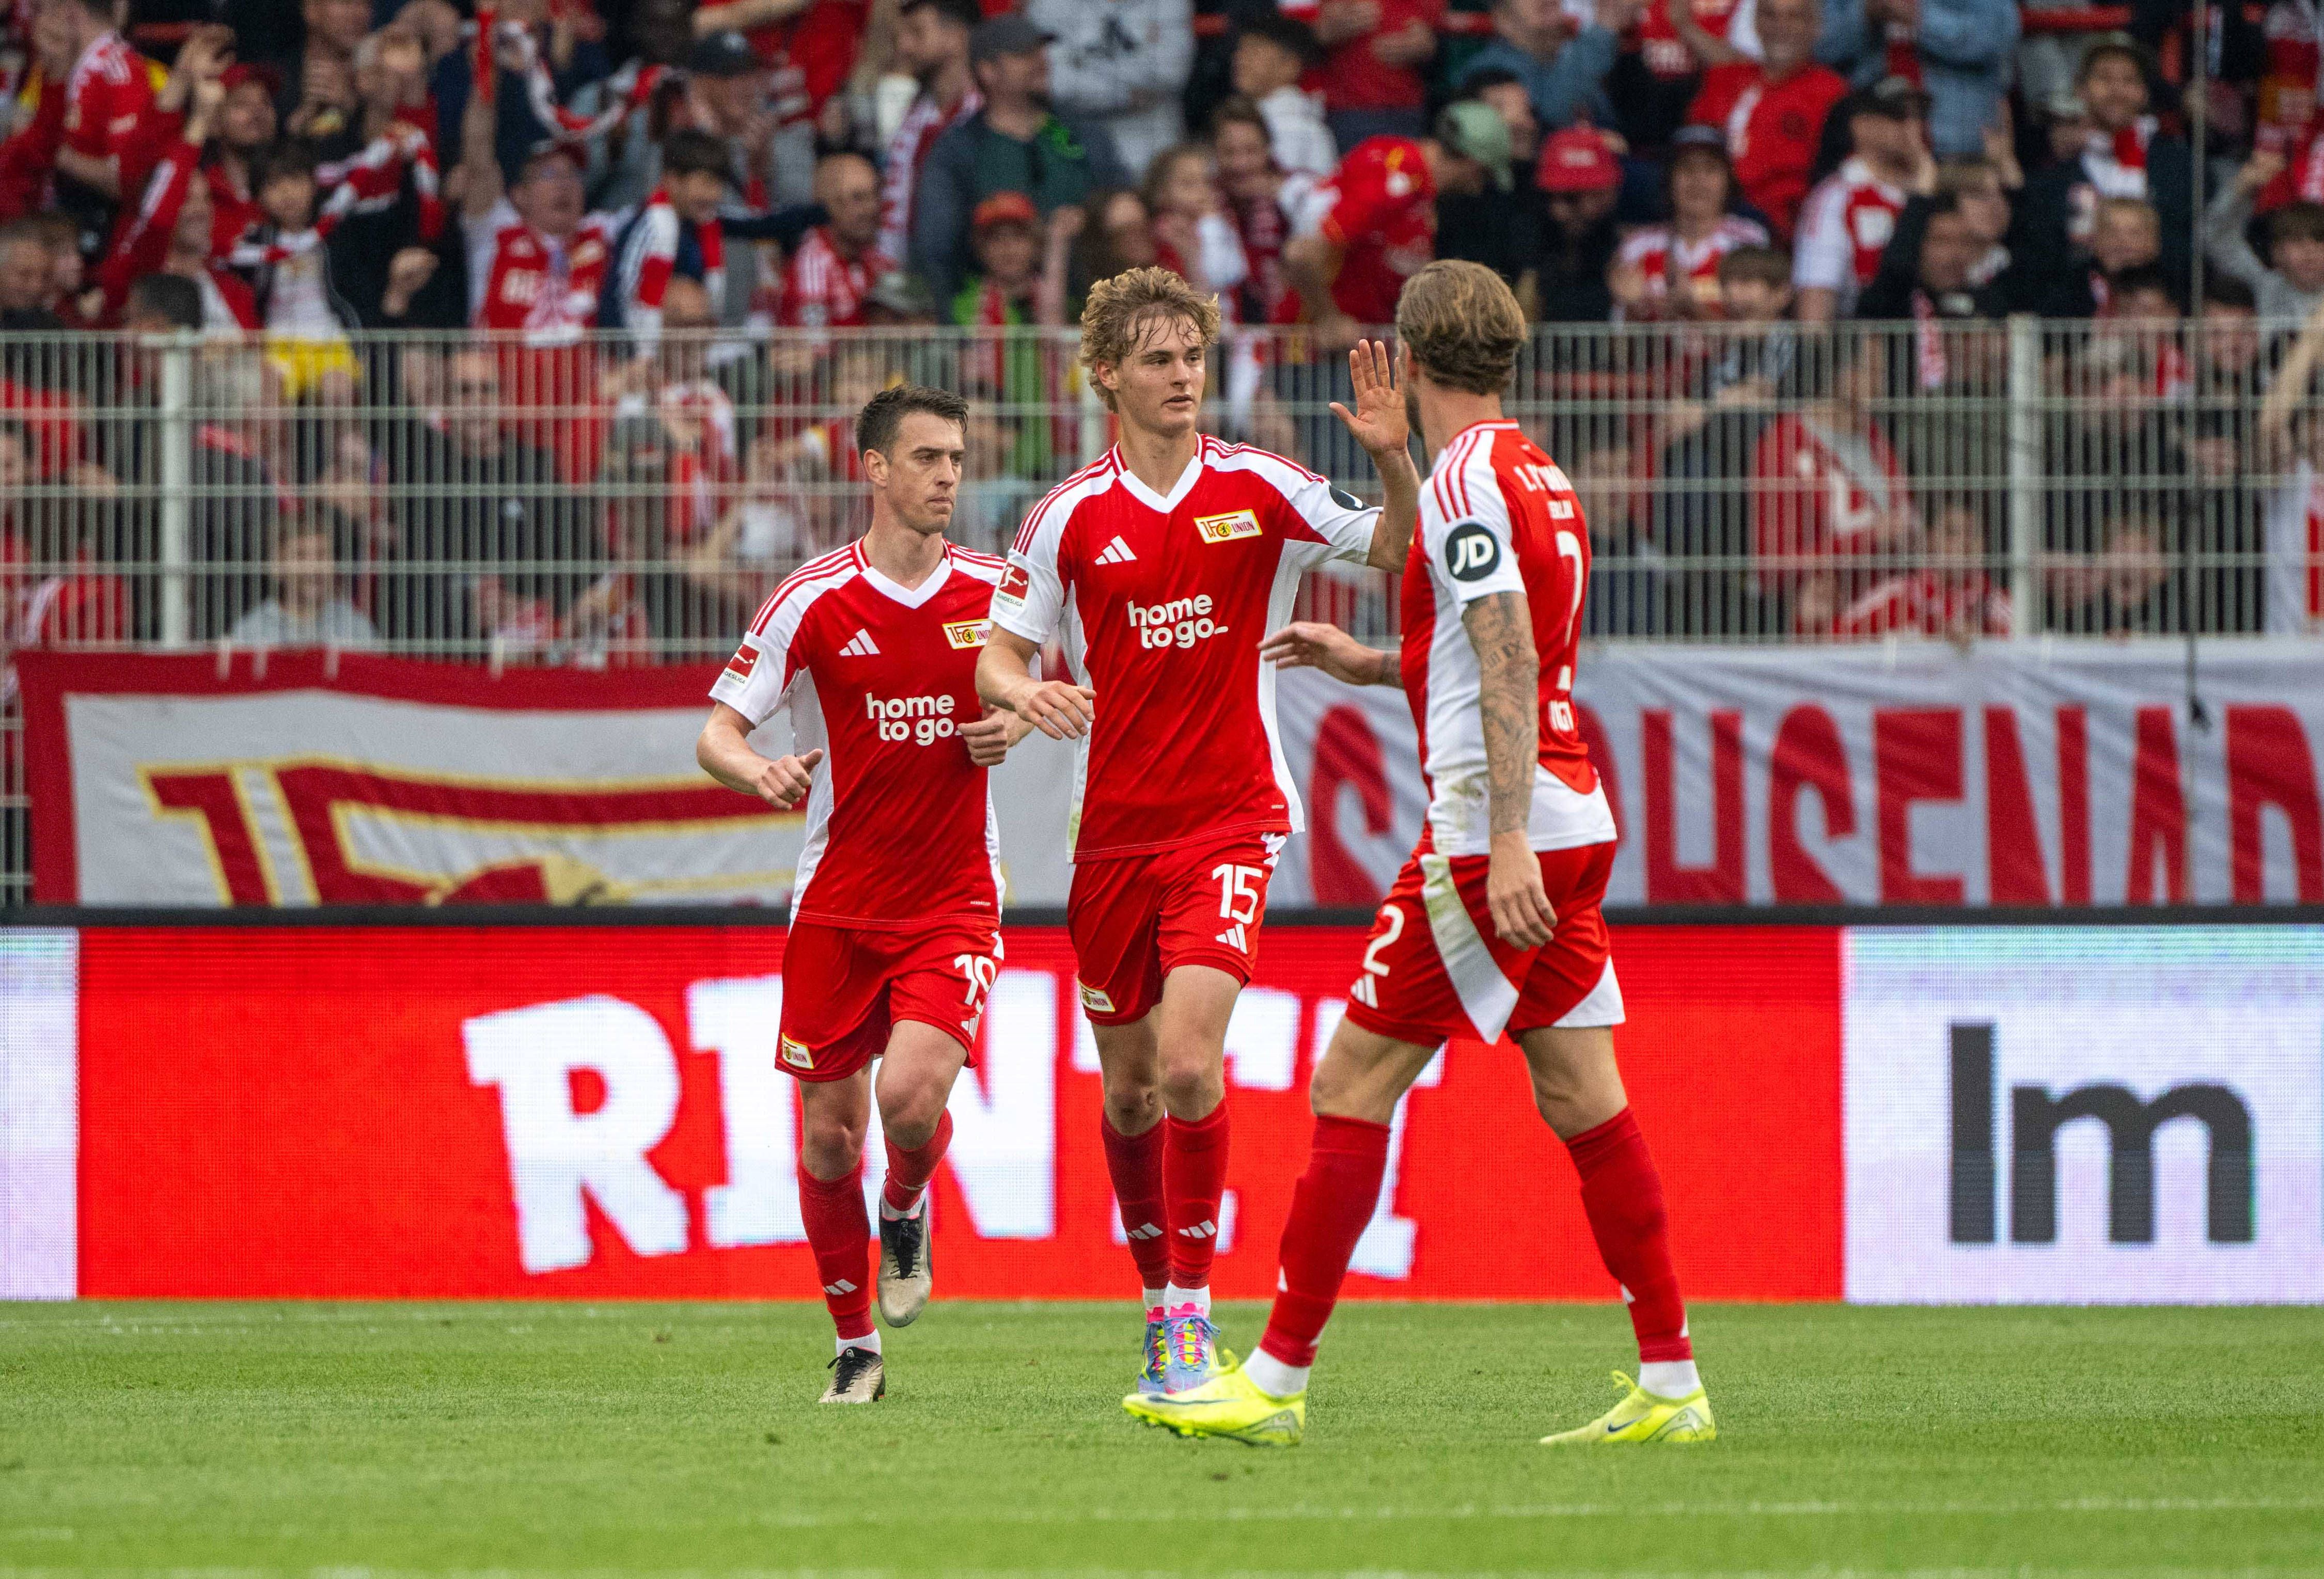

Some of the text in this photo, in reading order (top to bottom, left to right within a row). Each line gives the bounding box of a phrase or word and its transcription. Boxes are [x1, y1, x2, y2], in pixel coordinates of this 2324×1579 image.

[1231, 520, 1255, 533] UNION
[1453, 533, 1495, 575] JD
[996, 592, 1023, 607] BUNDESLIGA
[1127, 594, 1213, 627] home
[975, 629, 992, 640] UNI
[1140, 626, 1173, 649] to
[724, 671, 746, 684] DESLIGA
[865, 692, 955, 719] home
[879, 718, 910, 741] to
[1212, 863, 1263, 924] 15
[1362, 904, 1405, 977] 2
[954, 954, 997, 1015] 19
[1091, 997, 1109, 1006] UNION
[792, 1051, 808, 1063] UNION
[463, 970, 1447, 1276] RIN
